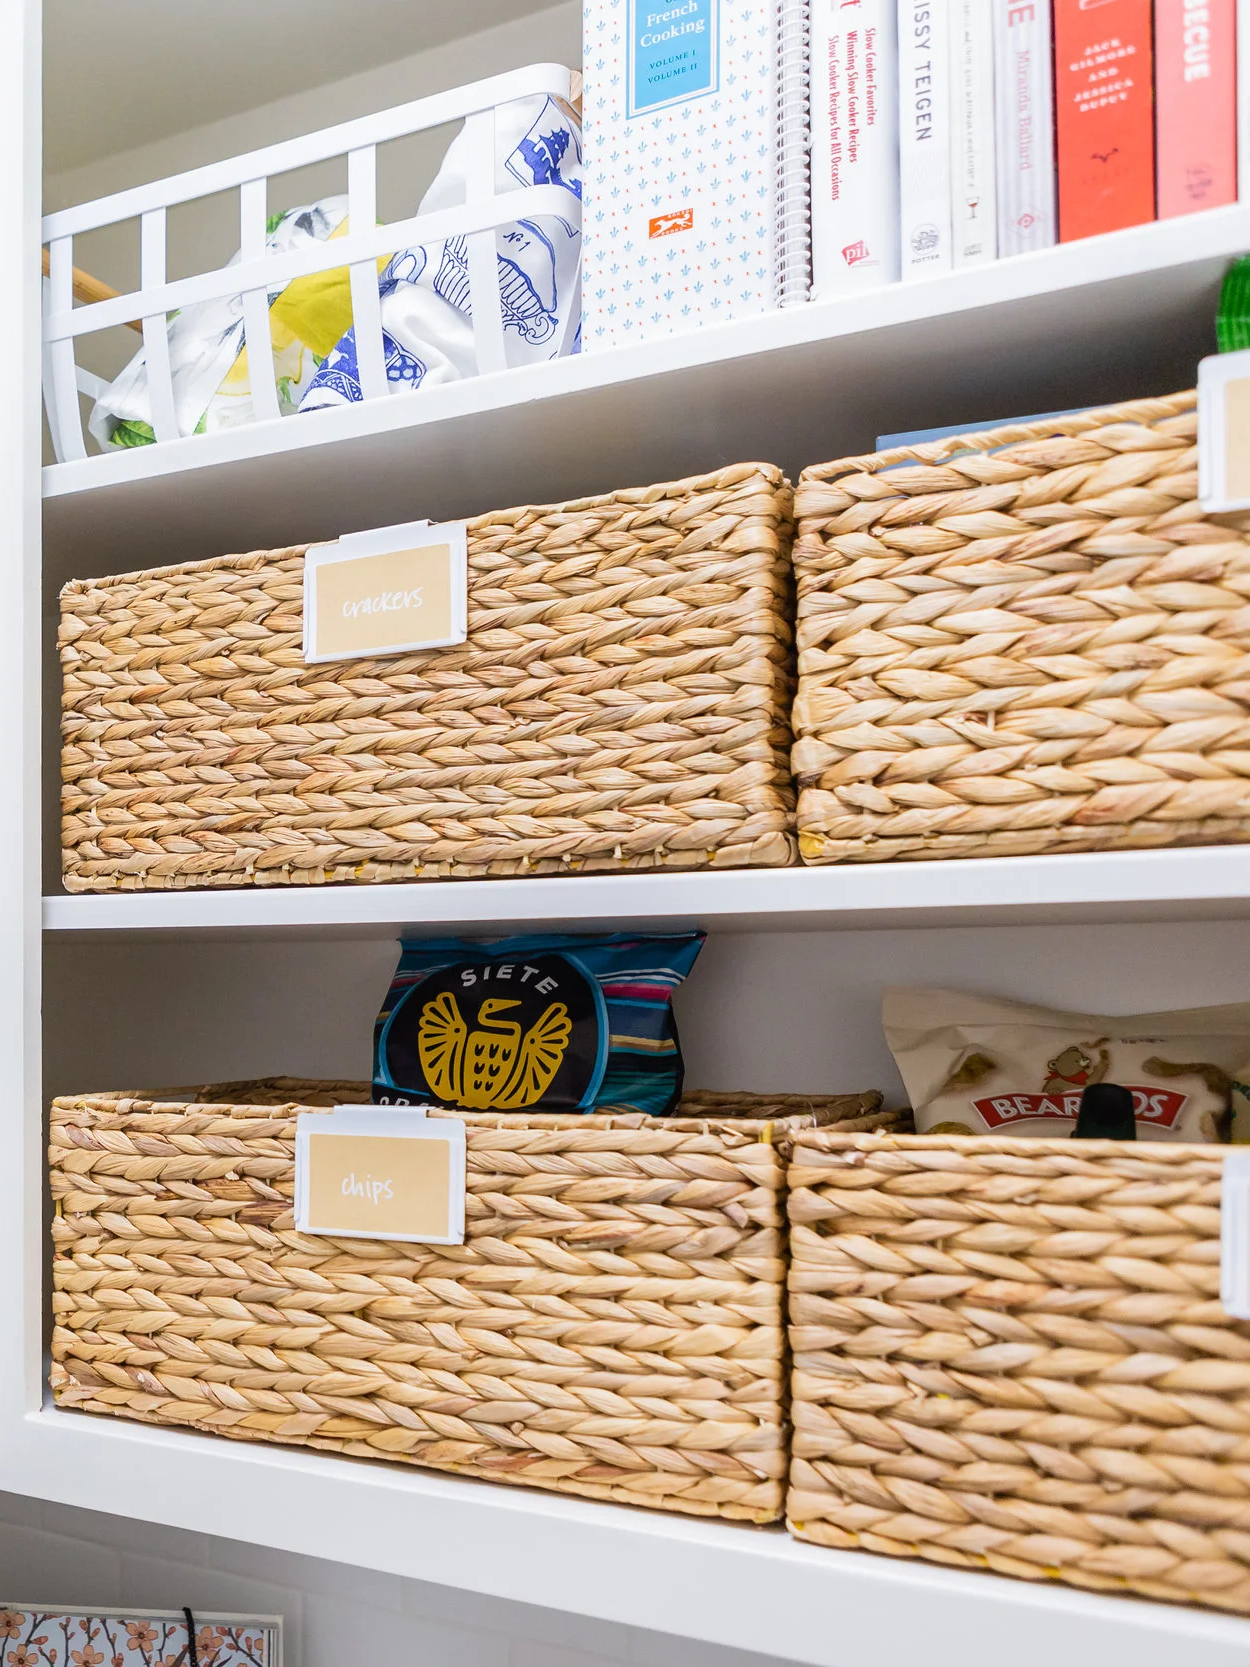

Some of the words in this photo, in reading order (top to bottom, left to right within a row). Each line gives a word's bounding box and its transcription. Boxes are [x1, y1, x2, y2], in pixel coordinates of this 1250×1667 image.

[646, 0, 699, 28] French
[914, 0, 931, 50] ISSY
[640, 18, 705, 47] Cooking
[828, 35, 839, 58] Slow
[865, 27, 876, 50] Slow
[649, 51, 689, 69] VOLUME
[845, 30, 858, 71] Winning
[647, 66, 687, 84] VOLUME
[828, 59, 840, 90] Cooker
[865, 52, 877, 82] Cooker
[847, 71, 859, 95] Slow
[828, 91, 841, 127] Recipes
[848, 96, 859, 127] Cooker
[866, 84, 877, 126] Favorites
[915, 60, 932, 141] TEIGEN
[830, 127, 841, 141] for
[830, 142, 842, 156] All
[847, 128, 860, 163] Recipes
[830, 156, 842, 201] Occasions
[342, 586, 425, 618] crackers
[459, 964, 560, 995] SIETE
[990, 1091, 1168, 1119] BEAROS
[341, 1172, 394, 1206] chips
